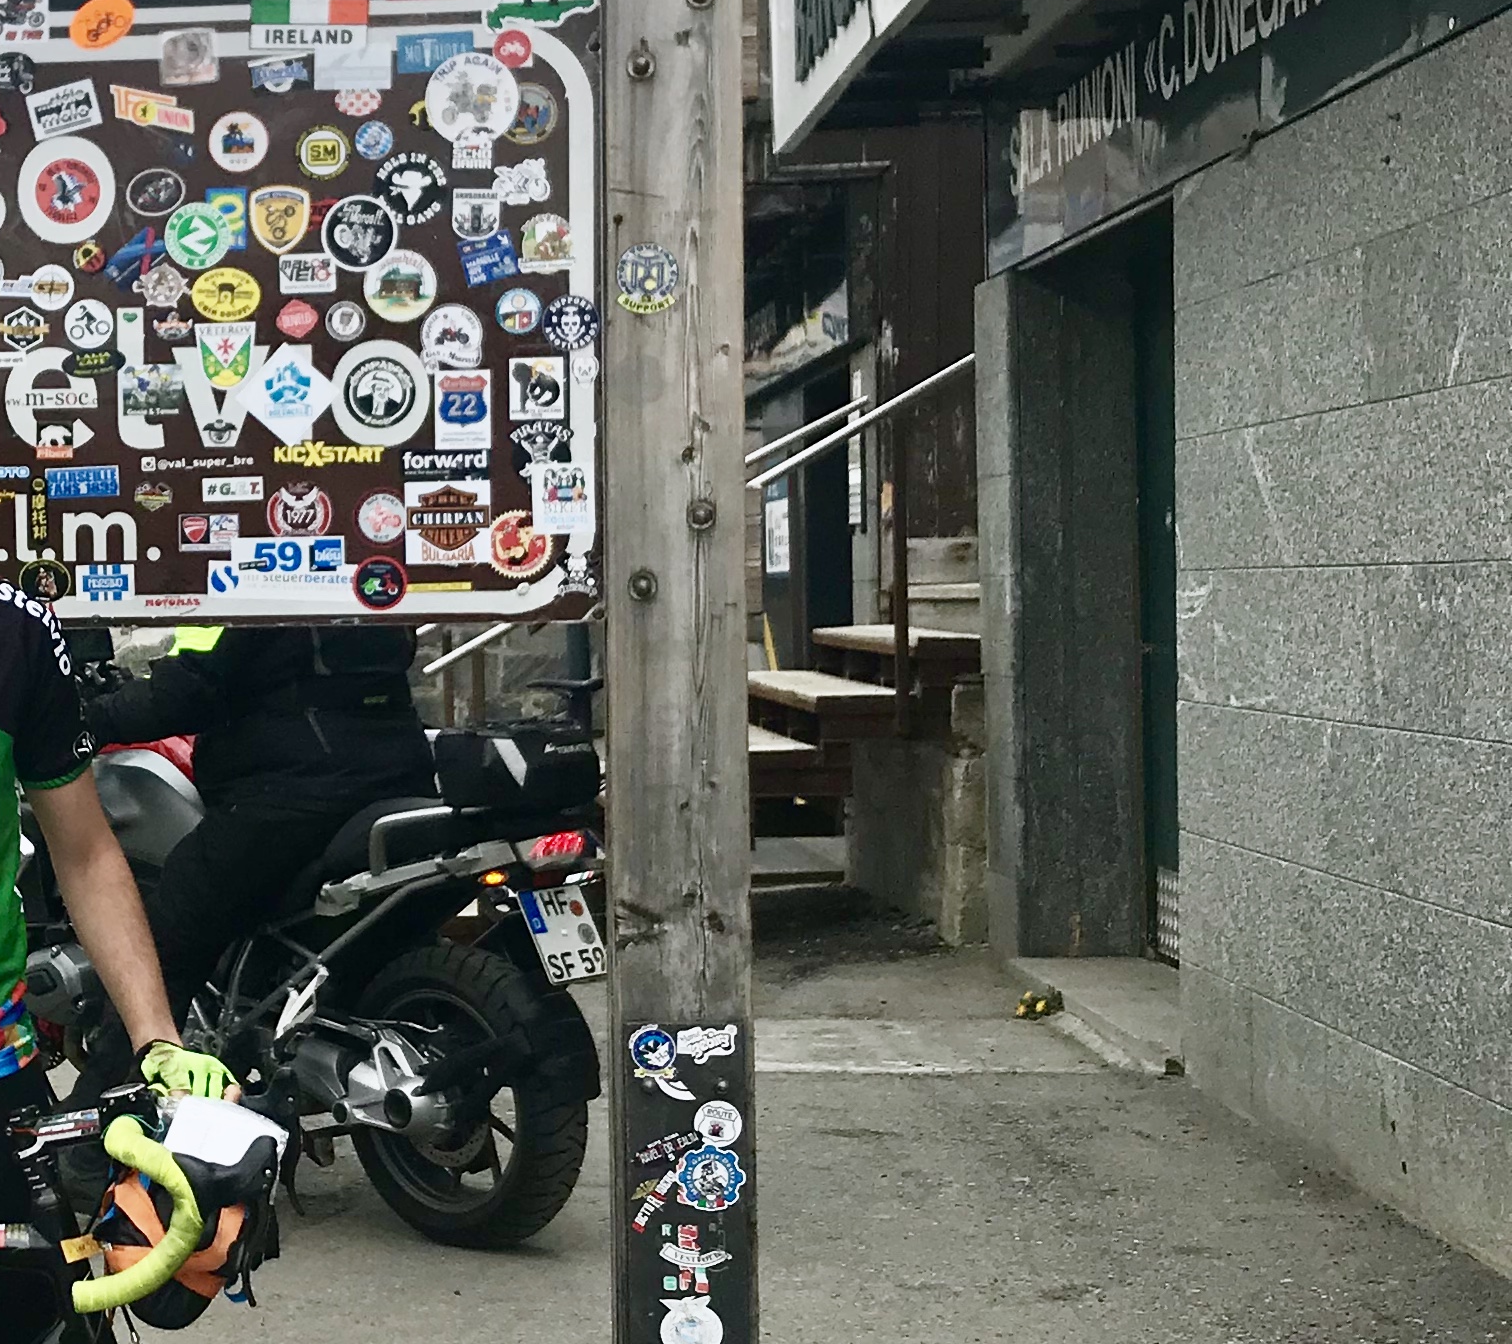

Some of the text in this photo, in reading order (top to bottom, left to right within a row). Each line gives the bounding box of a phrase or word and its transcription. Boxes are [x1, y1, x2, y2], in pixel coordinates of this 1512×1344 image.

[264, 28, 354, 46] IRELAND
[433, 60, 459, 83] TRIP
[1056, 41, 1137, 166] RIUNIONI
[309, 143, 337, 159] SM
[548, 295, 593, 313] SUPPORT
[446, 393, 479, 418] 22
[509, 419, 572, 444] PIRATAS
[402, 450, 487, 470] forward
[411, 510, 485, 526] CHIRPAN
[254, 541, 303, 573] 59
[421, 541, 475, 563] BULGARIA
[538, 888, 569, 918] HF
[546, 951, 576, 981] SF
[706, 1108, 734, 1121] ROUTE
